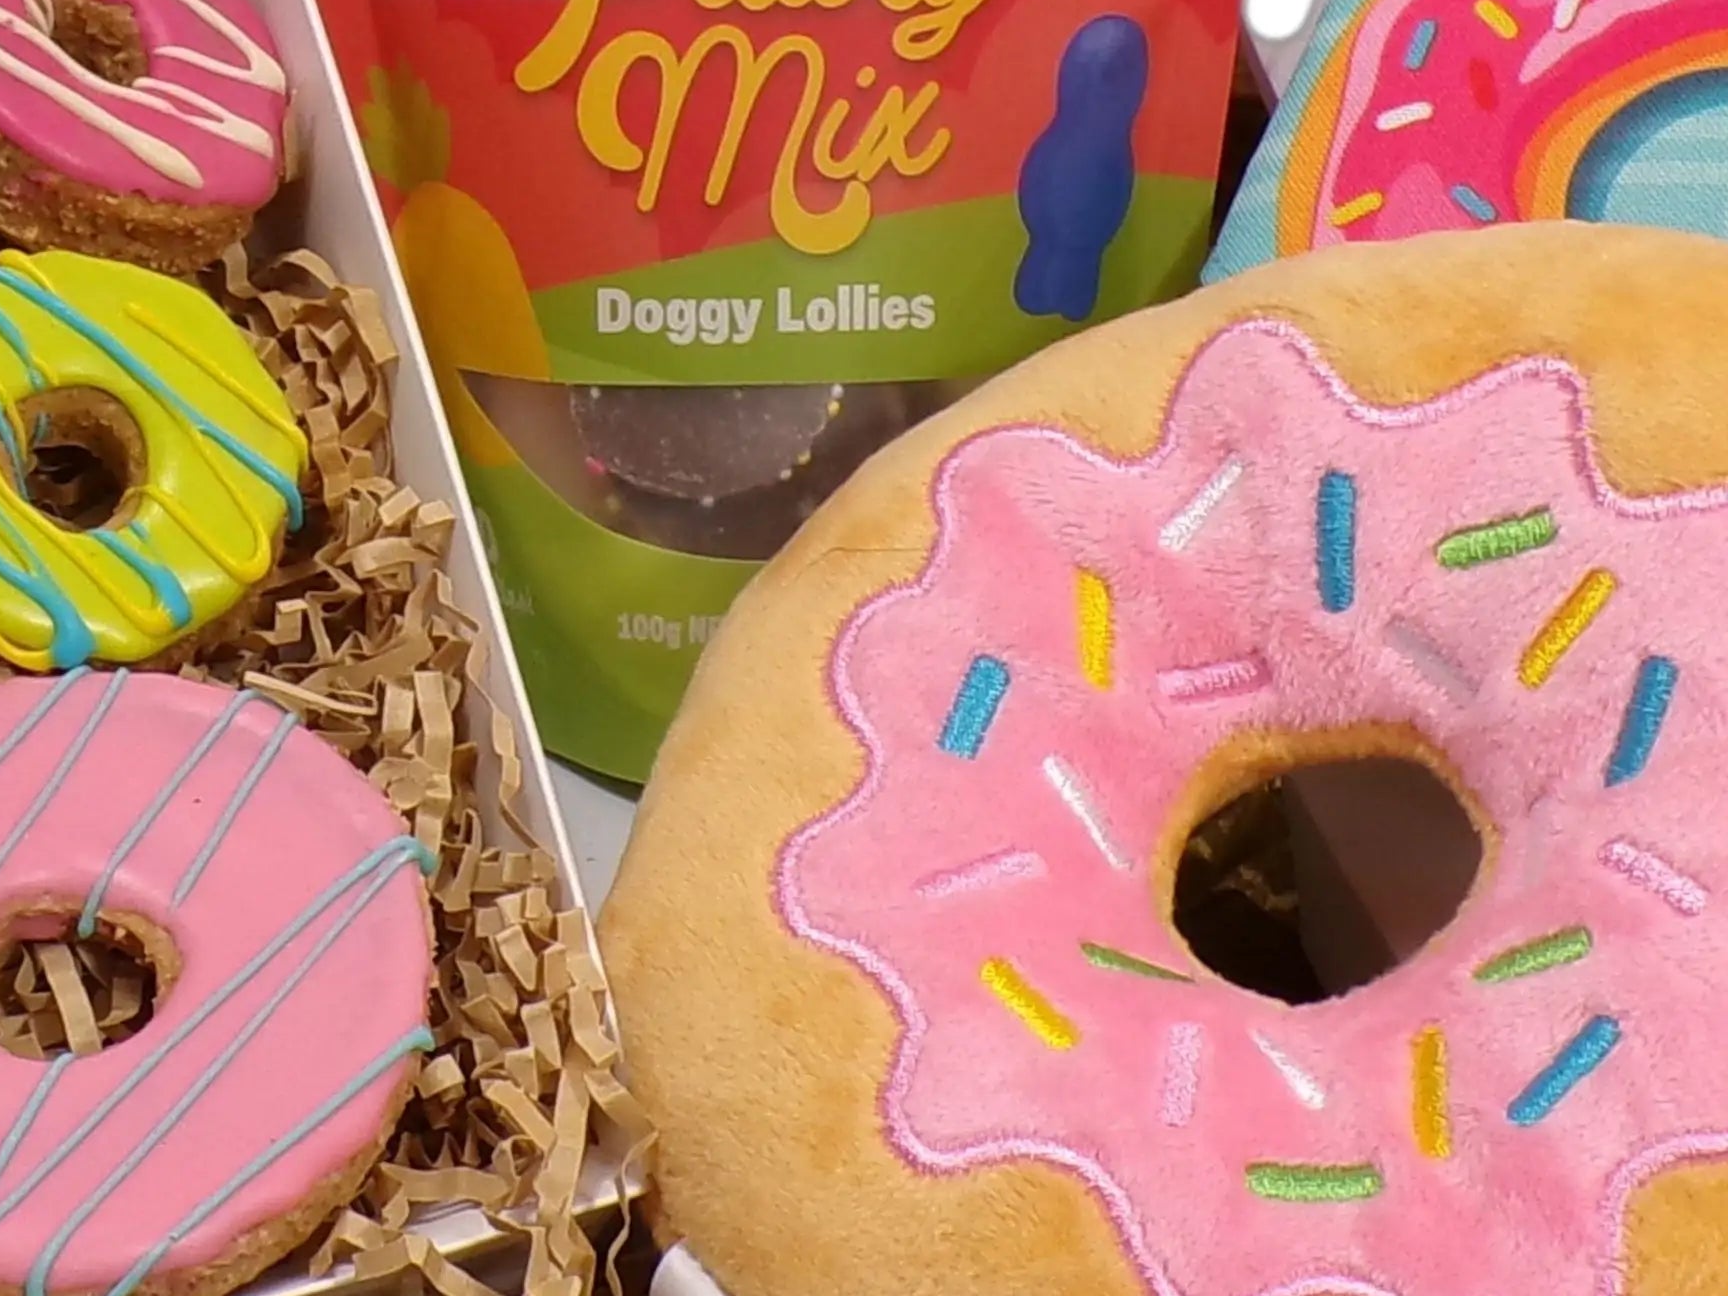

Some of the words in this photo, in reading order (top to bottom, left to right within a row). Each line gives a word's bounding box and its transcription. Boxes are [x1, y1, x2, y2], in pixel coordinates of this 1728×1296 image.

[576, 24, 952, 254] Mix
[596, 287, 762, 346] Doggy
[776, 284, 936, 334] Lollies
[617, 612, 682, 651] 100g
